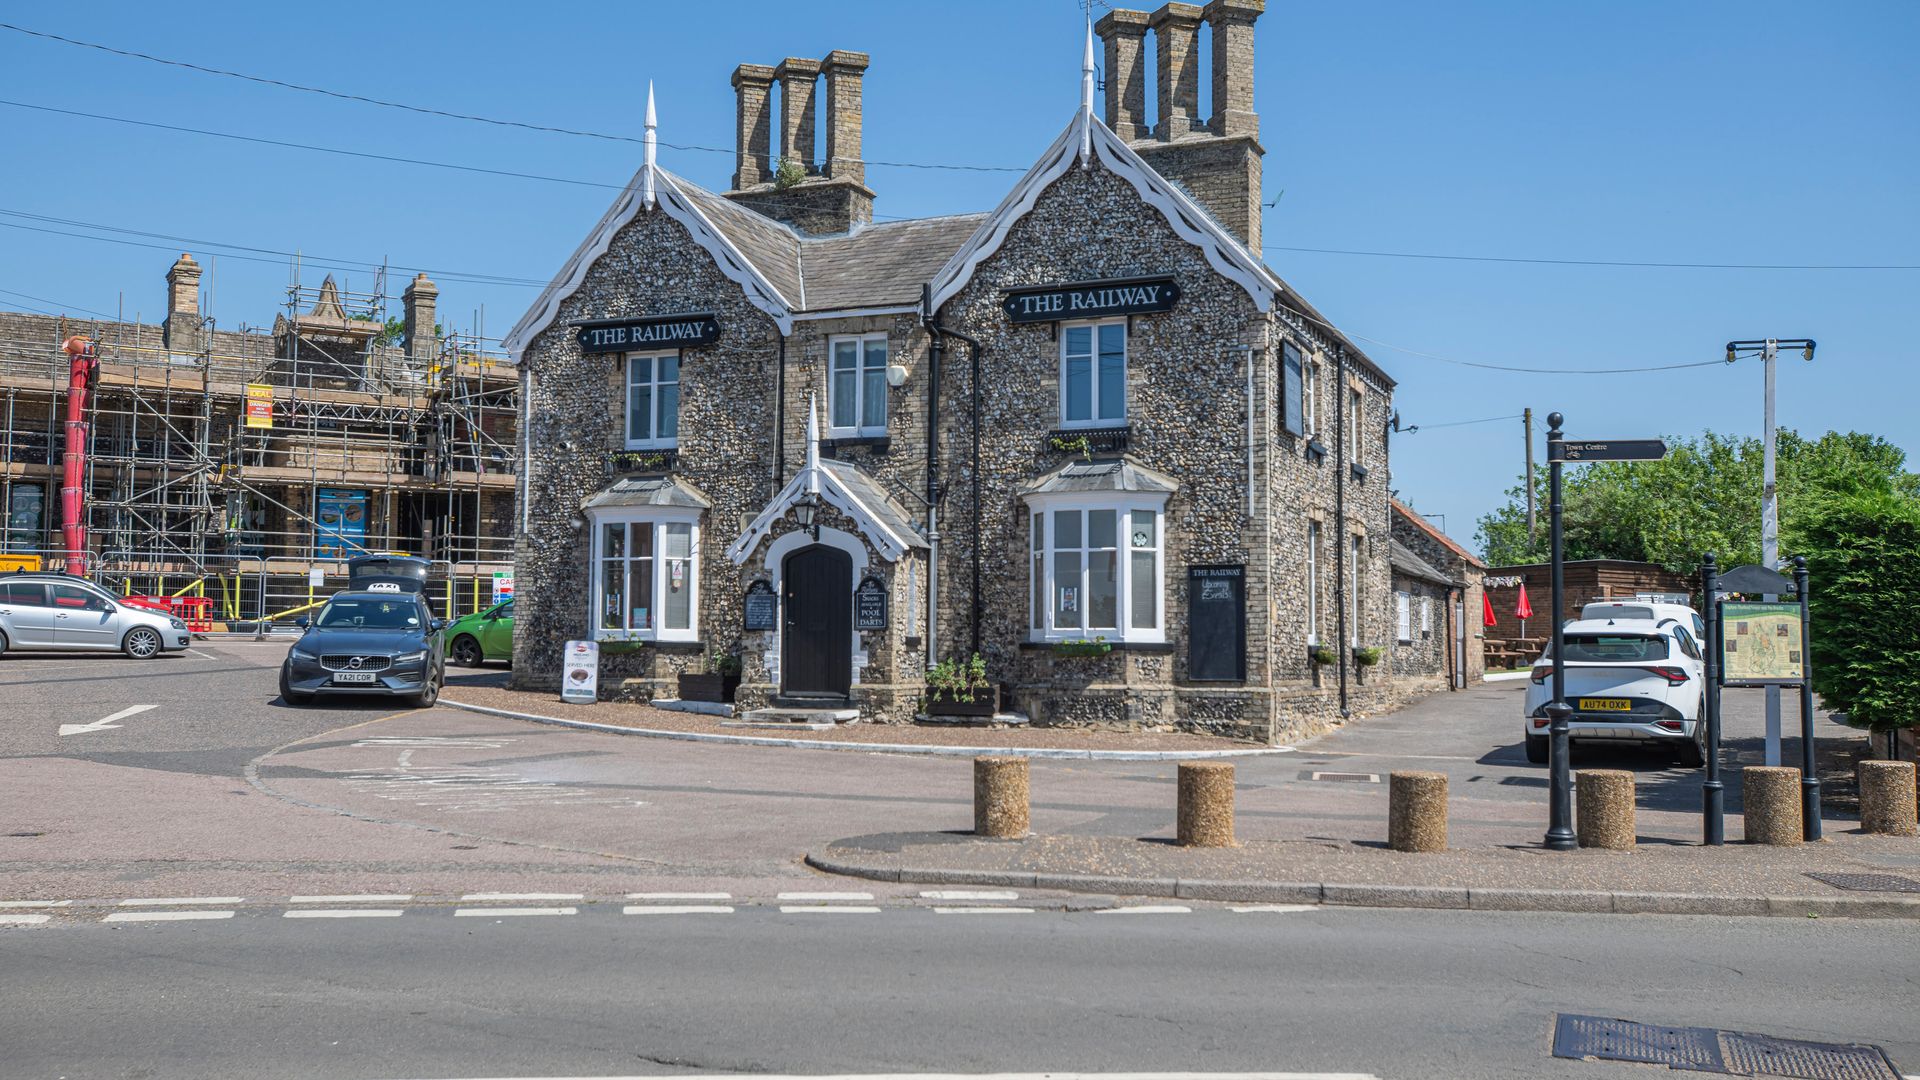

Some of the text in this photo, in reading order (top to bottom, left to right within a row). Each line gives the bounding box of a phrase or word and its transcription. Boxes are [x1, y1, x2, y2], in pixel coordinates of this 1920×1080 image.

[1019, 285, 1161, 314] THE RAILWAY
[590, 321, 705, 346] THE RAILWAY
[1585, 443, 1607, 451] Centre
[1193, 568, 1241, 577] THE RAILWAY
[861, 609, 881, 617] POOL
[338, 673, 355, 681] YA21
[1584, 700, 1627, 709] AU74 OXK
